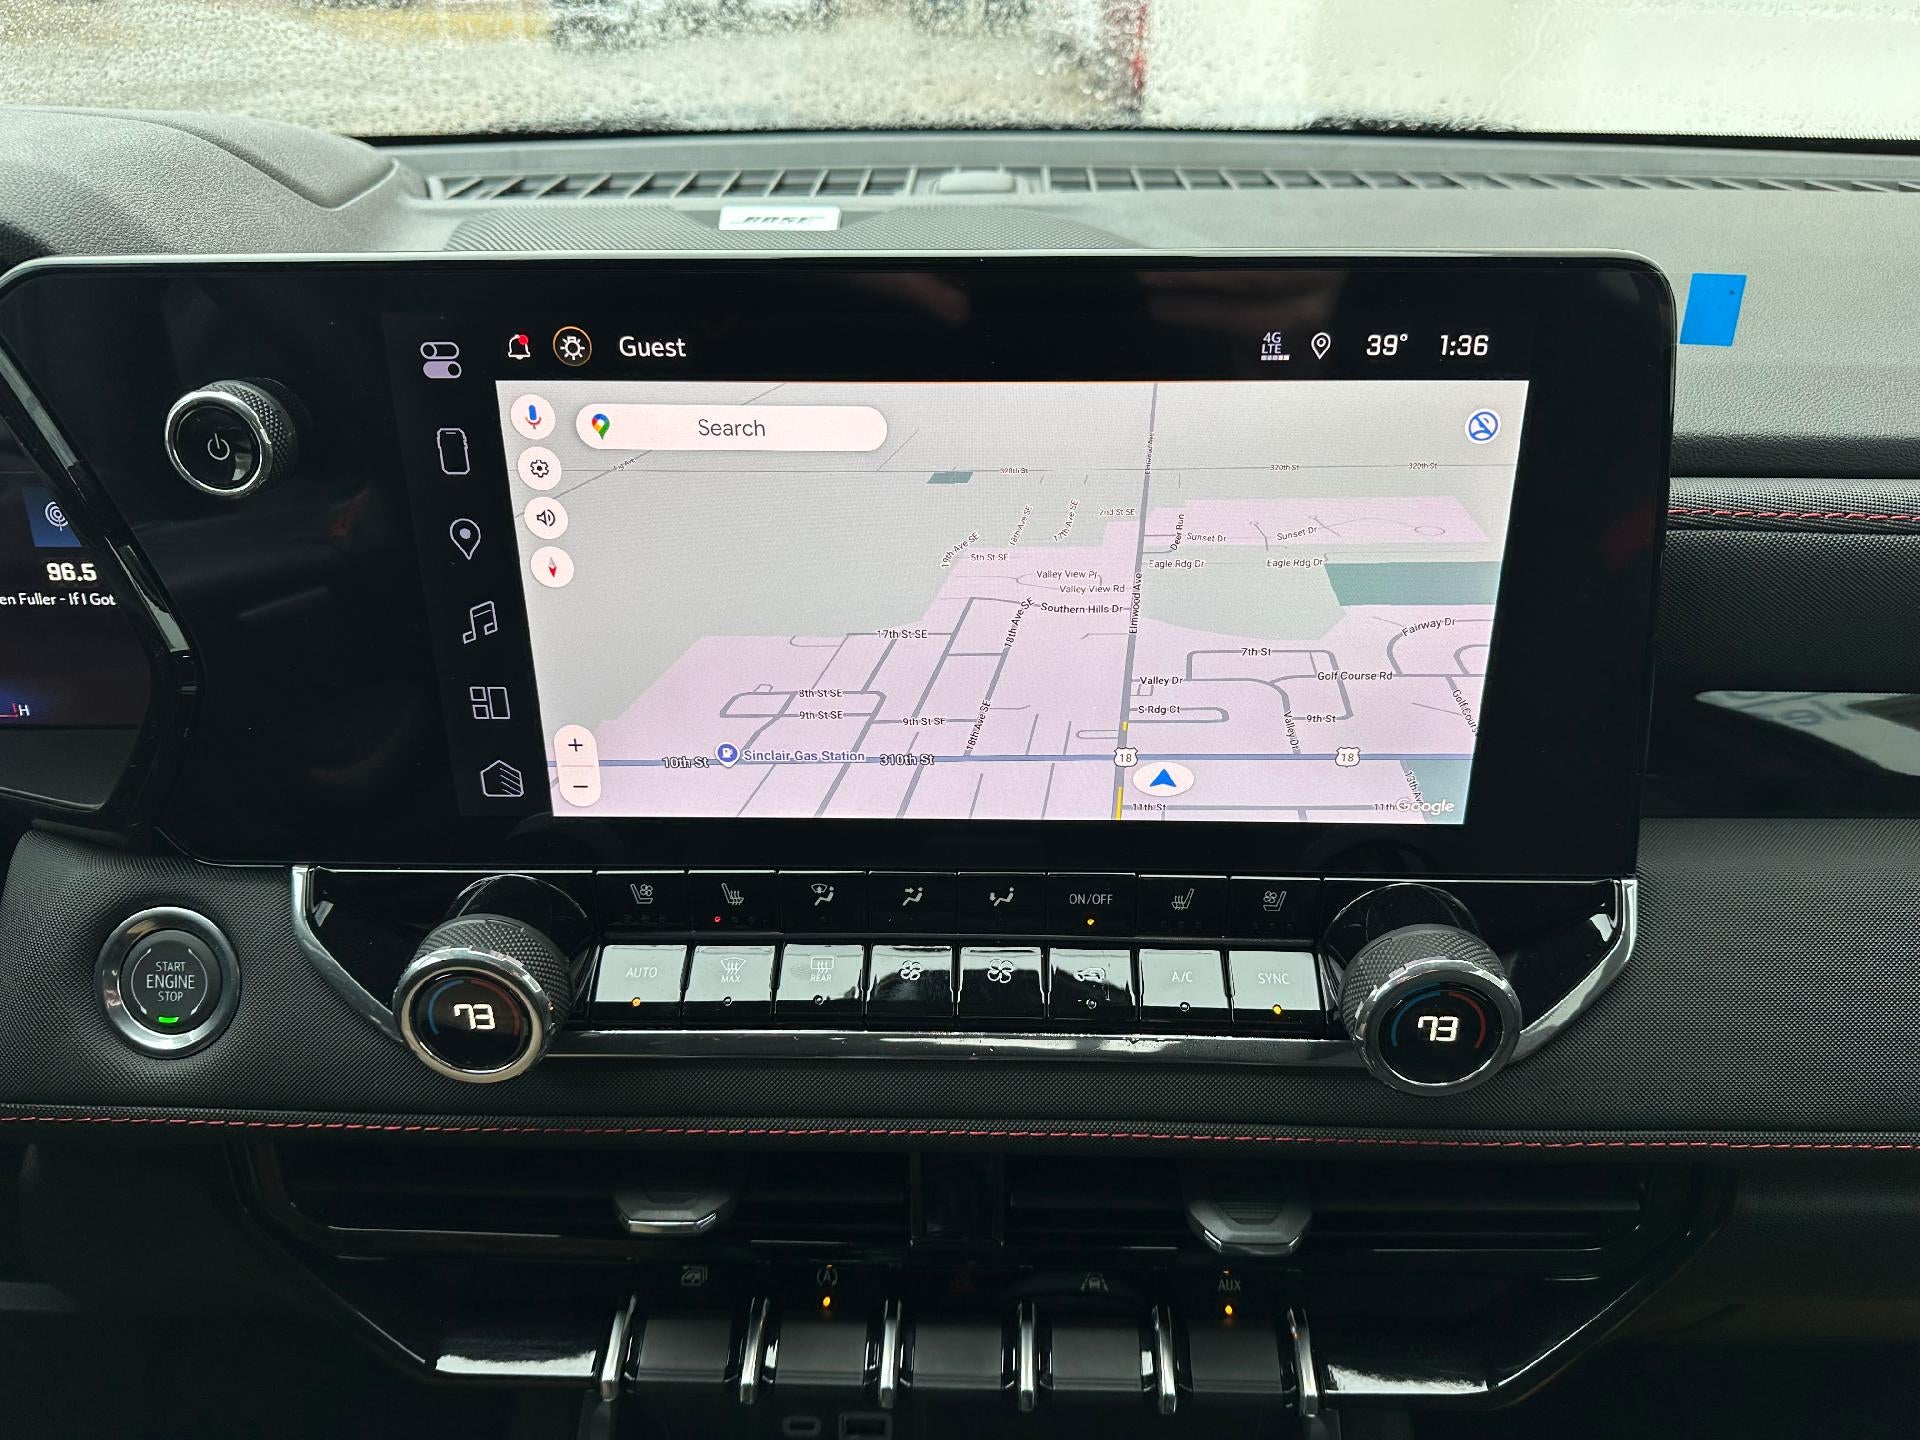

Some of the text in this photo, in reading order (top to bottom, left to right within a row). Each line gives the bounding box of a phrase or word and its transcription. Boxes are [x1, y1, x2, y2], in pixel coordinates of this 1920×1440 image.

[1263, 332, 1281, 343] 4G
[619, 336, 687, 357] Guest
[1261, 344, 1281, 354] LTE
[1366, 333, 1408, 356] 39°
[1440, 334, 1489, 356] 1:36
[698, 418, 766, 438] Search
[1070, 499, 1079, 510] SE
[1170, 514, 1185, 550] Deer Run
[1187, 532, 1215, 542] Sunset
[1277, 526, 1318, 541] Sunset Dr
[942, 531, 980, 567] 19th Ave SE
[1150, 560, 1172, 569] Eagle
[1175, 560, 1192, 569] Rdg
[1267, 559, 1290, 569] Eagle
[1293, 559, 1311, 568] Rdg
[46, 562, 97, 581] 96.5
[1036, 570, 1062, 580] Valley
[1065, 570, 1086, 578] View
[1060, 585, 1086, 595] Valley
[1089, 585, 1110, 593] View
[19, 592, 56, 605] Fuller
[69, 592, 79, 605] If
[82, 592, 87, 605] I
[90, 592, 117, 605] Got
[1129, 573, 1142, 634] Elmwood Ave
[1041, 602, 1123, 613] Southern Hills Dr
[1005, 597, 1035, 647] 18th Ave SE
[1402, 617, 1456, 636] Fairway Dr
[877, 630, 927, 638] 17th St SE
[1241, 647, 1271, 656] 7th St
[1317, 671, 1393, 680] Golf Course Rd
[1140, 677, 1169, 686] Valley
[799, 689, 842, 697] 8th St SE
[1453, 690, 1468, 707] Golf
[19, 704, 30, 716] H
[800, 711, 843, 719] 9th St SE
[1138, 706, 1180, 715] S Rdg Ct
[903, 717, 945, 726] 9th St SE
[1307, 714, 1336, 723] 9th St
[966, 700, 990, 750] 18th Ave SE
[1284, 711, 1299, 749] Valley Dr
[744, 750, 865, 761] Sinclair Gas Station
[880, 754, 934, 765] 310th St
[1119, 754, 1132, 763] 18
[1341, 753, 1354, 762] 18
[662, 757, 709, 768] 10th St
[1405, 771, 1418, 791] 13th
[1396, 797, 1455, 815] Google
[1069, 893, 1113, 905] ON/OFF
[155, 961, 186, 972] START
[625, 966, 658, 978] AUTO
[146, 974, 195, 989] ENGINE
[721, 975, 741, 983] MAX
[810, 974, 832, 982] REAR
[1171, 971, 1193, 984] A/C
[1257, 972, 1290, 985] SYNC
[158, 991, 183, 1002] STOP
[453, 1003, 495, 1030] 73
[1417, 1015, 1459, 1041] 73
[1217, 1279, 1242, 1291] AUX
